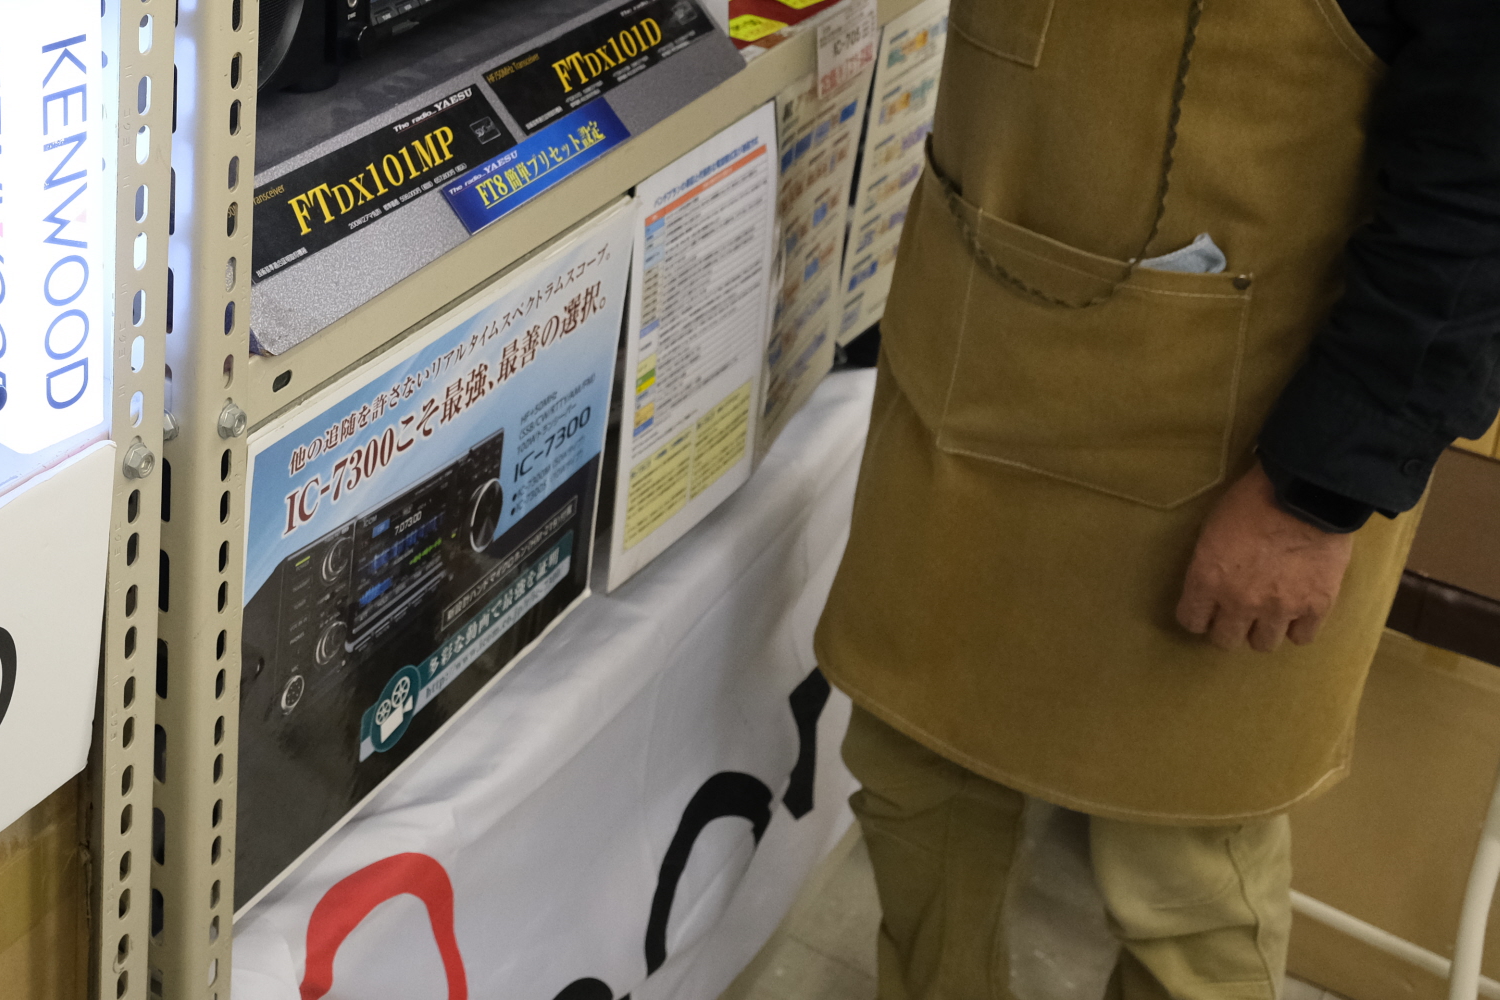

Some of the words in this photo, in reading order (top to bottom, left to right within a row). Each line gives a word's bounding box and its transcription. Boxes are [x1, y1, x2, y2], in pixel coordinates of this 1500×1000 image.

[512, 53, 540, 72] Transceiver
[552, 17, 662, 93] FTDX101D
[393, 120, 410, 133] The
[434, 88, 473, 112] YAESU
[288, 126, 454, 236] FTDX101MP
[449, 185, 462, 196] The
[483, 150, 518, 175] YAESU
[42, 33, 90, 410] KENWOOD
[289, 243, 610, 476] 他の追随を許さないリアルタイムスペクトラムスコープ。
[283, 280, 606, 537] IC-7300こそ最強、最善の選択。
[514, 406, 591, 483] IC-7300
[428, 546, 560, 678] 多彩な動画で最強を証明
